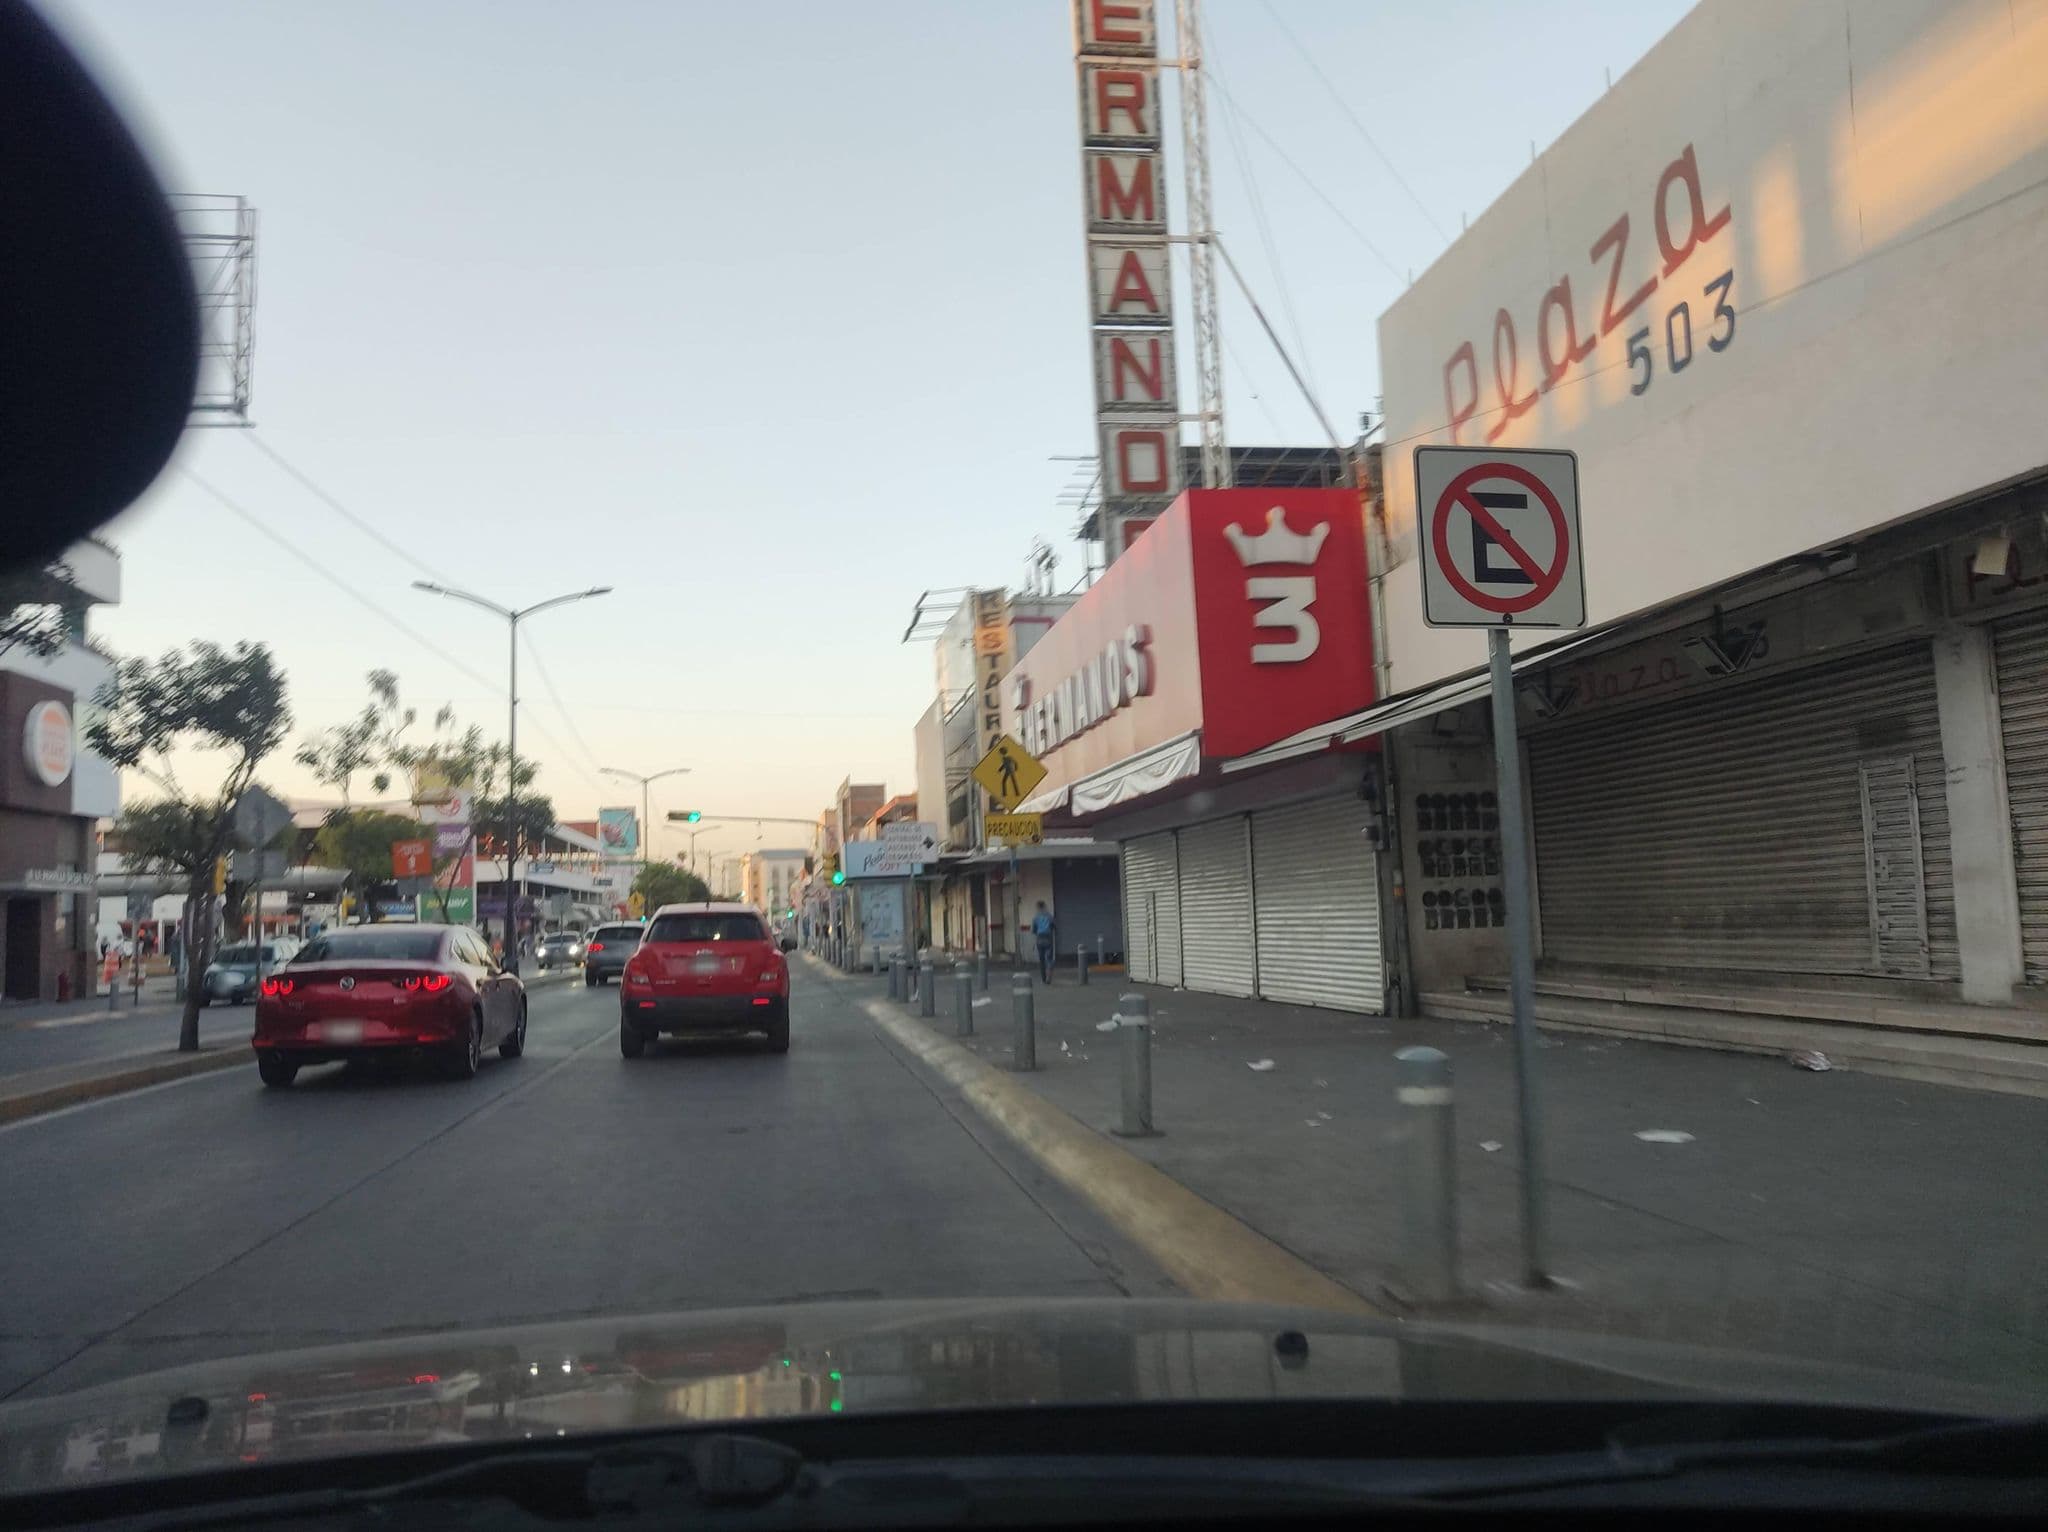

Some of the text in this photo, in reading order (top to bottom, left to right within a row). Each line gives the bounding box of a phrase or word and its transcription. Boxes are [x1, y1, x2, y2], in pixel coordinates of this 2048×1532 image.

[1091, 0, 1169, 552] ERMANO
[1443, 142, 1732, 446] Plaza
[1625, 268, 1737, 397] 503
[1470, 491, 1537, 585] E
[1246, 575, 1321, 664] 3
[1023, 623, 1157, 758] HERMANOS
